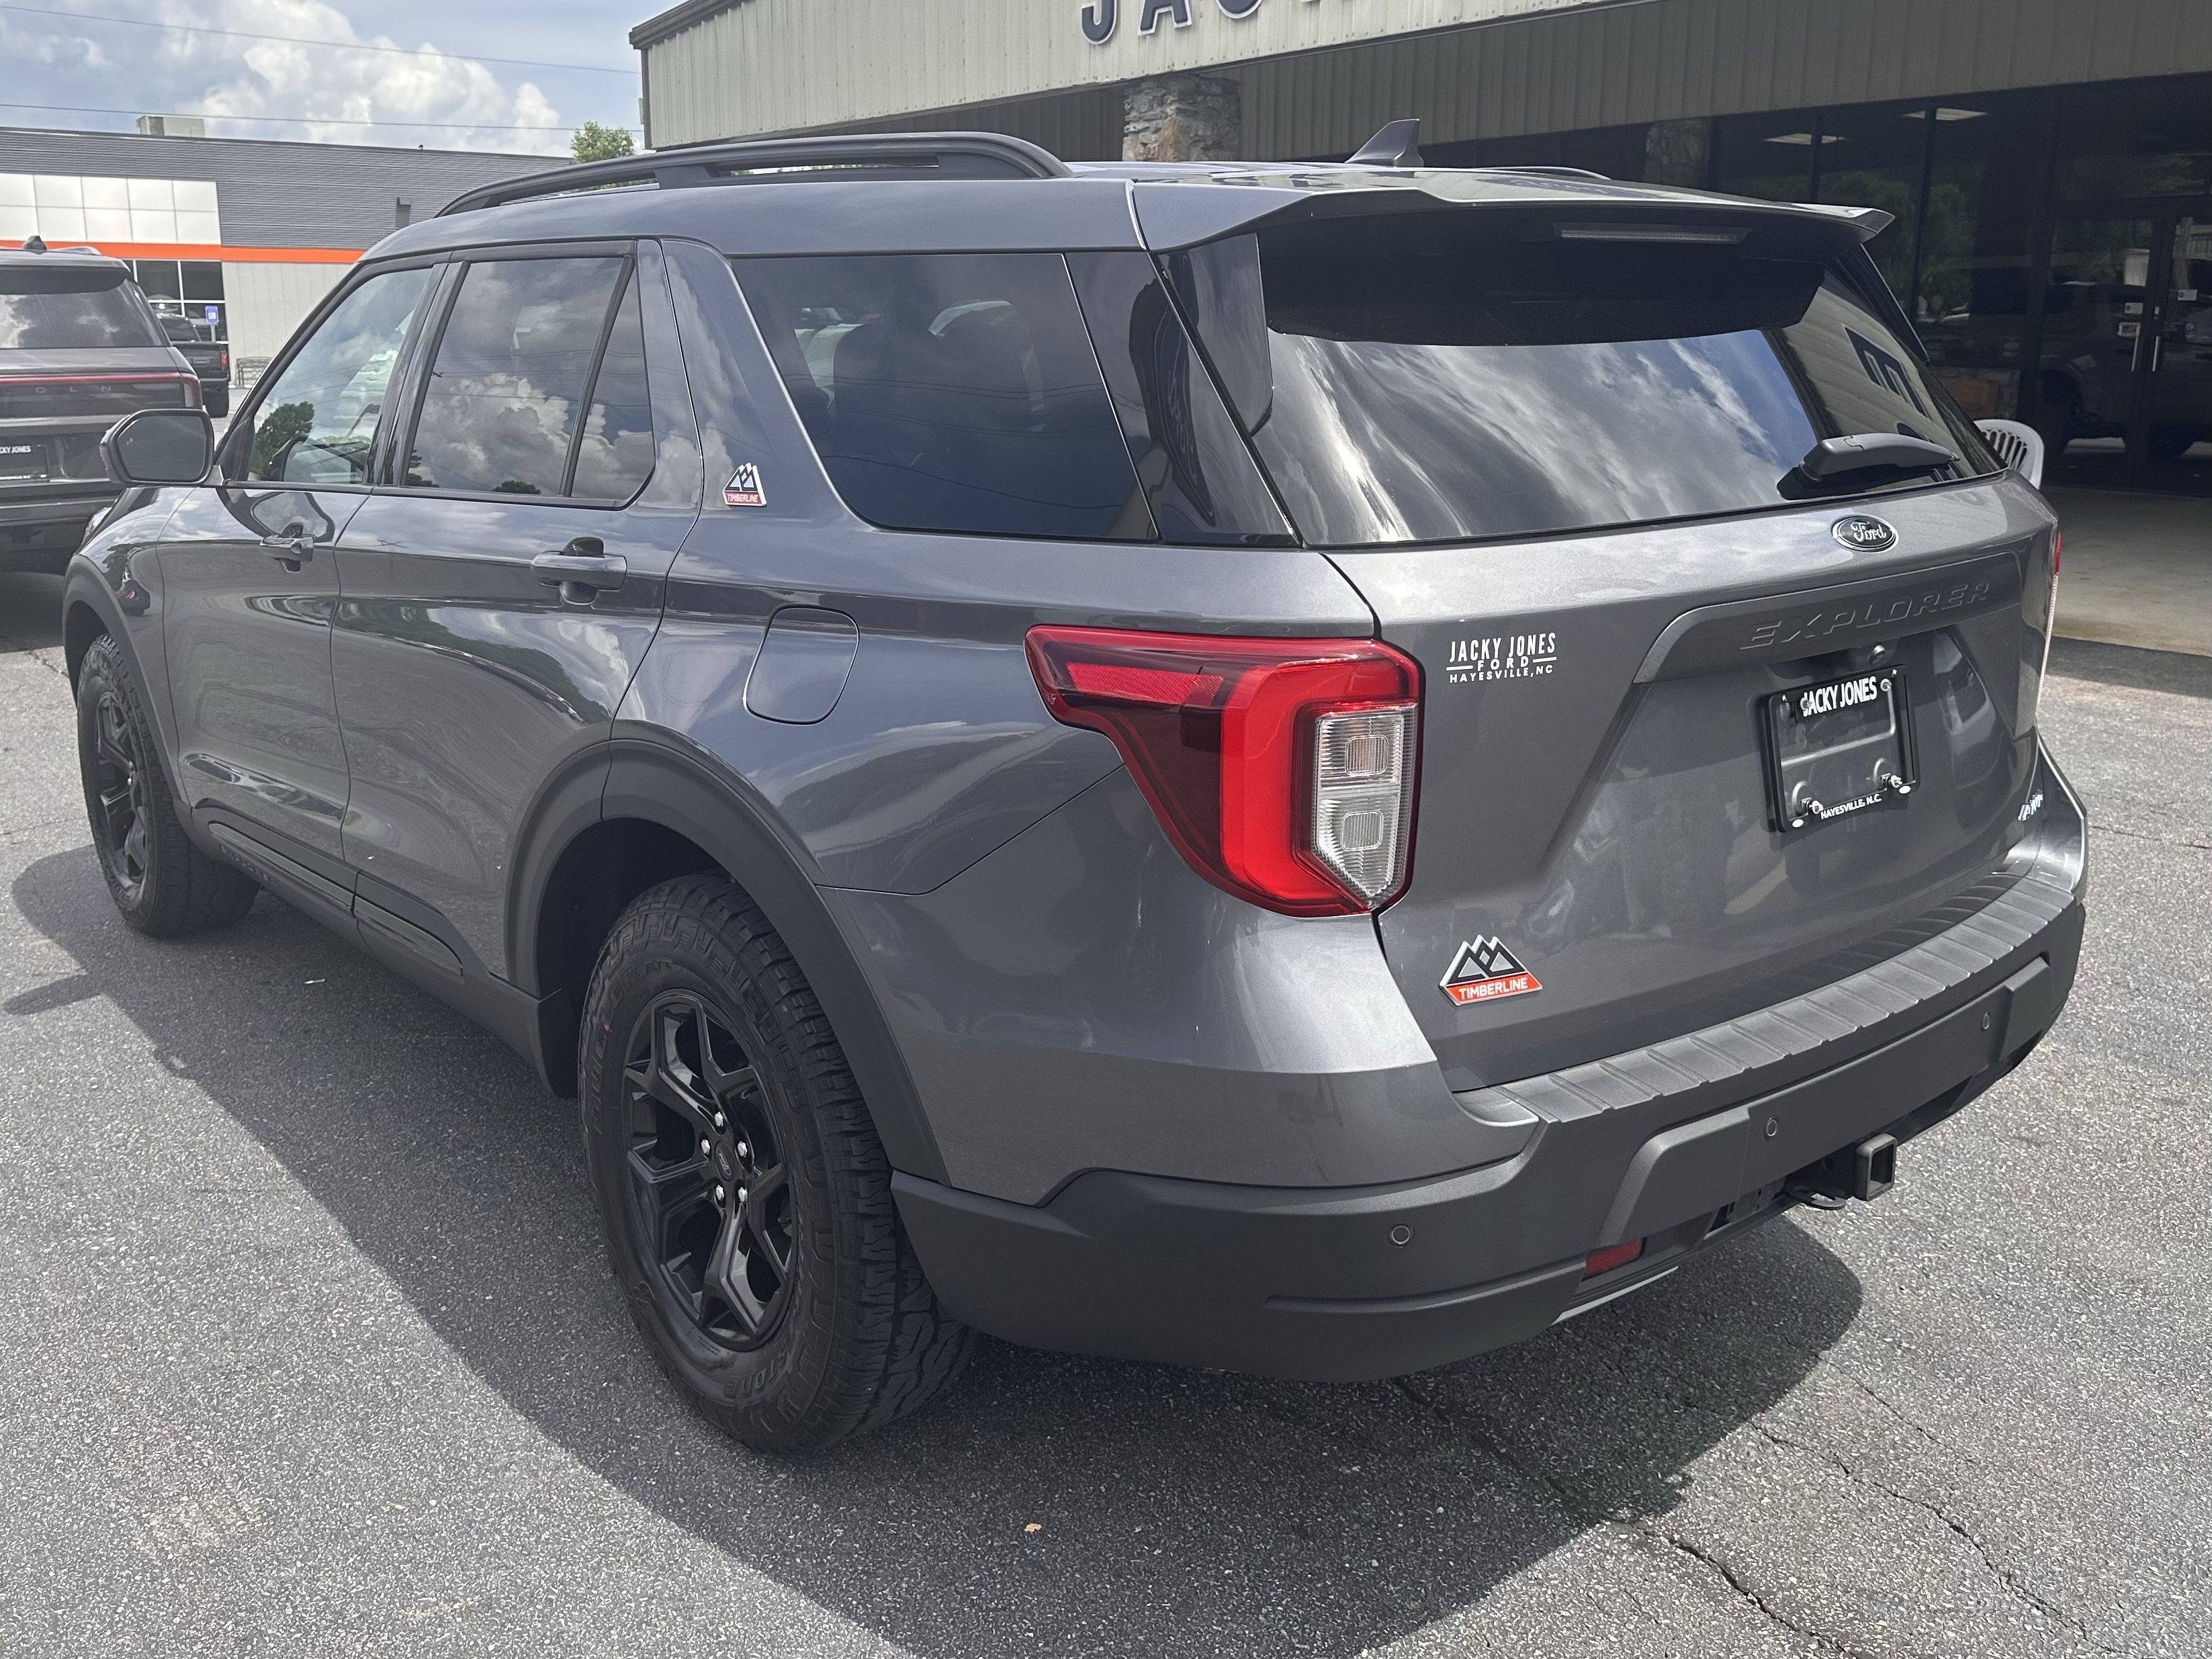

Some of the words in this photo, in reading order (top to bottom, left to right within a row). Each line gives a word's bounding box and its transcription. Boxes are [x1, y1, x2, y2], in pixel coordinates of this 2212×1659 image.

[727, 494, 759, 502] TIMBERLINE
[1850, 521, 1887, 542] Ford
[1740, 578, 1990, 650] EXPLORER
[1450, 637, 1502, 663] JACKY
[1509, 632, 1556, 658] JONES
[1477, 656, 1530, 672] FORD
[1839, 676, 1878, 709] JONES
[1458, 977, 1529, 1000] TIMBERLINE
